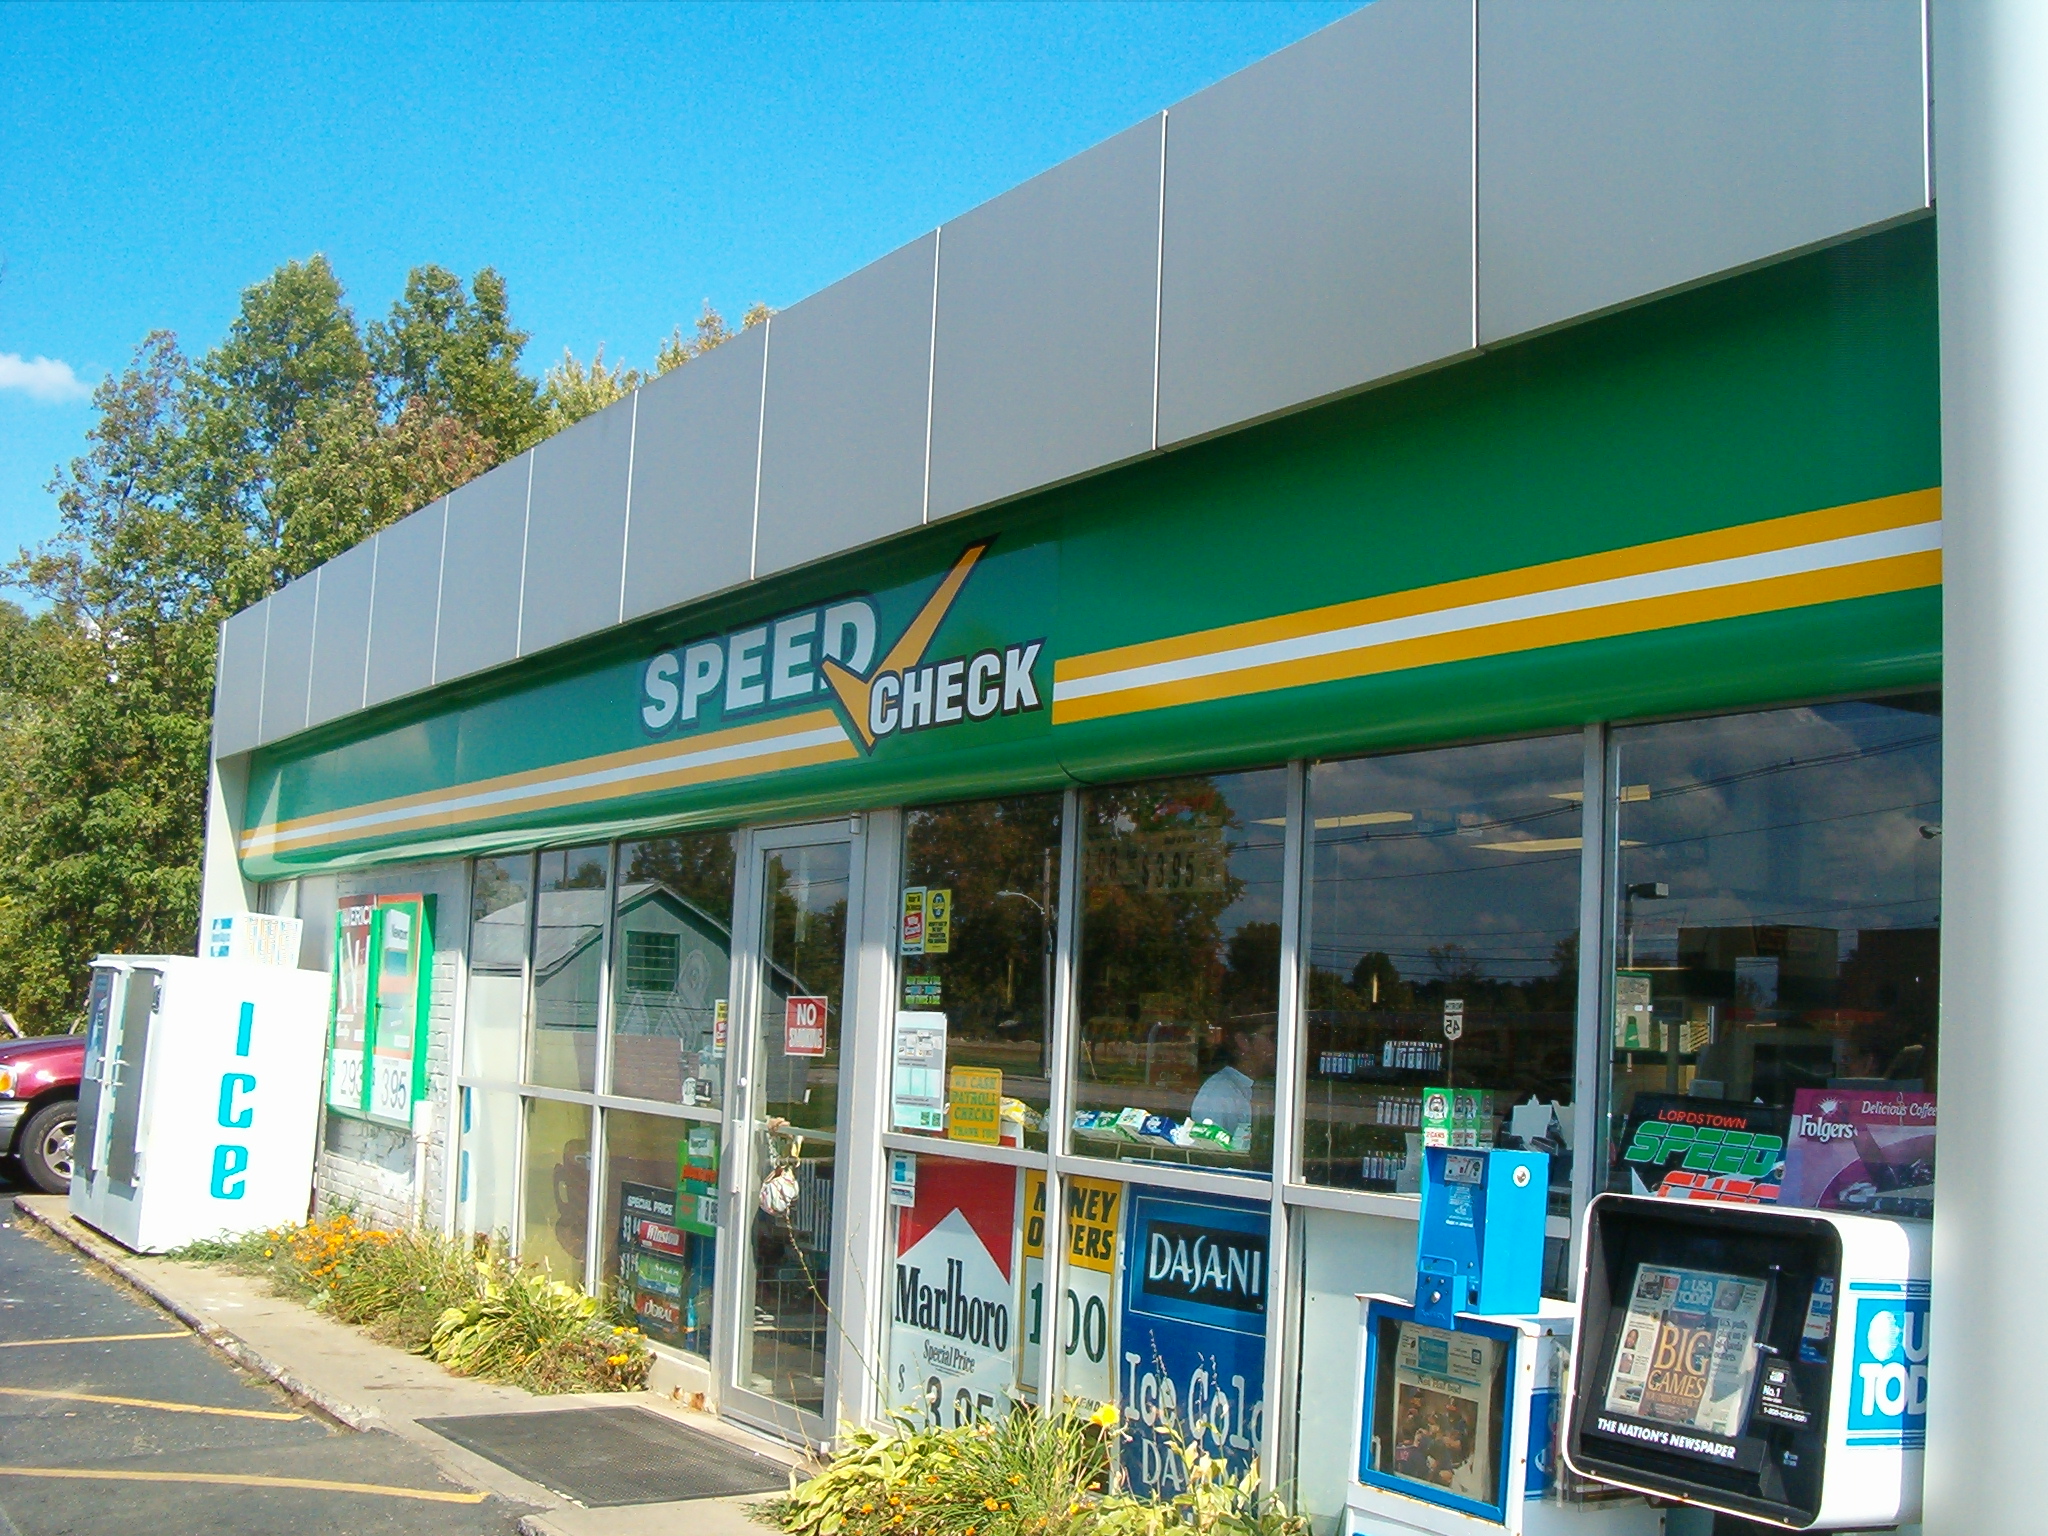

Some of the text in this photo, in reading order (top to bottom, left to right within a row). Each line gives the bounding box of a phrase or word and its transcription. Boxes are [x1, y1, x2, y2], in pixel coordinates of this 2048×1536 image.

[641, 600, 878, 730] SPEED
[868, 643, 1042, 735] CHECK
[796, 1003, 817, 1026] NO
[1658, 1109, 1748, 1130] LORDSTOWN
[1800, 1113, 1854, 1143] Folgers
[1861, 1100, 1907, 1116] Delicious
[1624, 1120, 1784, 1177] SPEED
[1033, 1181, 1118, 1224] MNEY
[646, 1224, 681, 1248] Winston
[1148, 1231, 1262, 1297] DASANI
[895, 1256, 1009, 1353] Marlboro
[1692, 1279, 1713, 1295] USA
[923, 1338, 976, 1374] Special Price
[1653, 1325, 1713, 1376] BIG
[1124, 1352, 1178, 1430] Ice
[1647, 1369, 1707, 1399] GAMES
[1597, 1417, 1737, 1461] THE NATION'S NEWSPAPER
